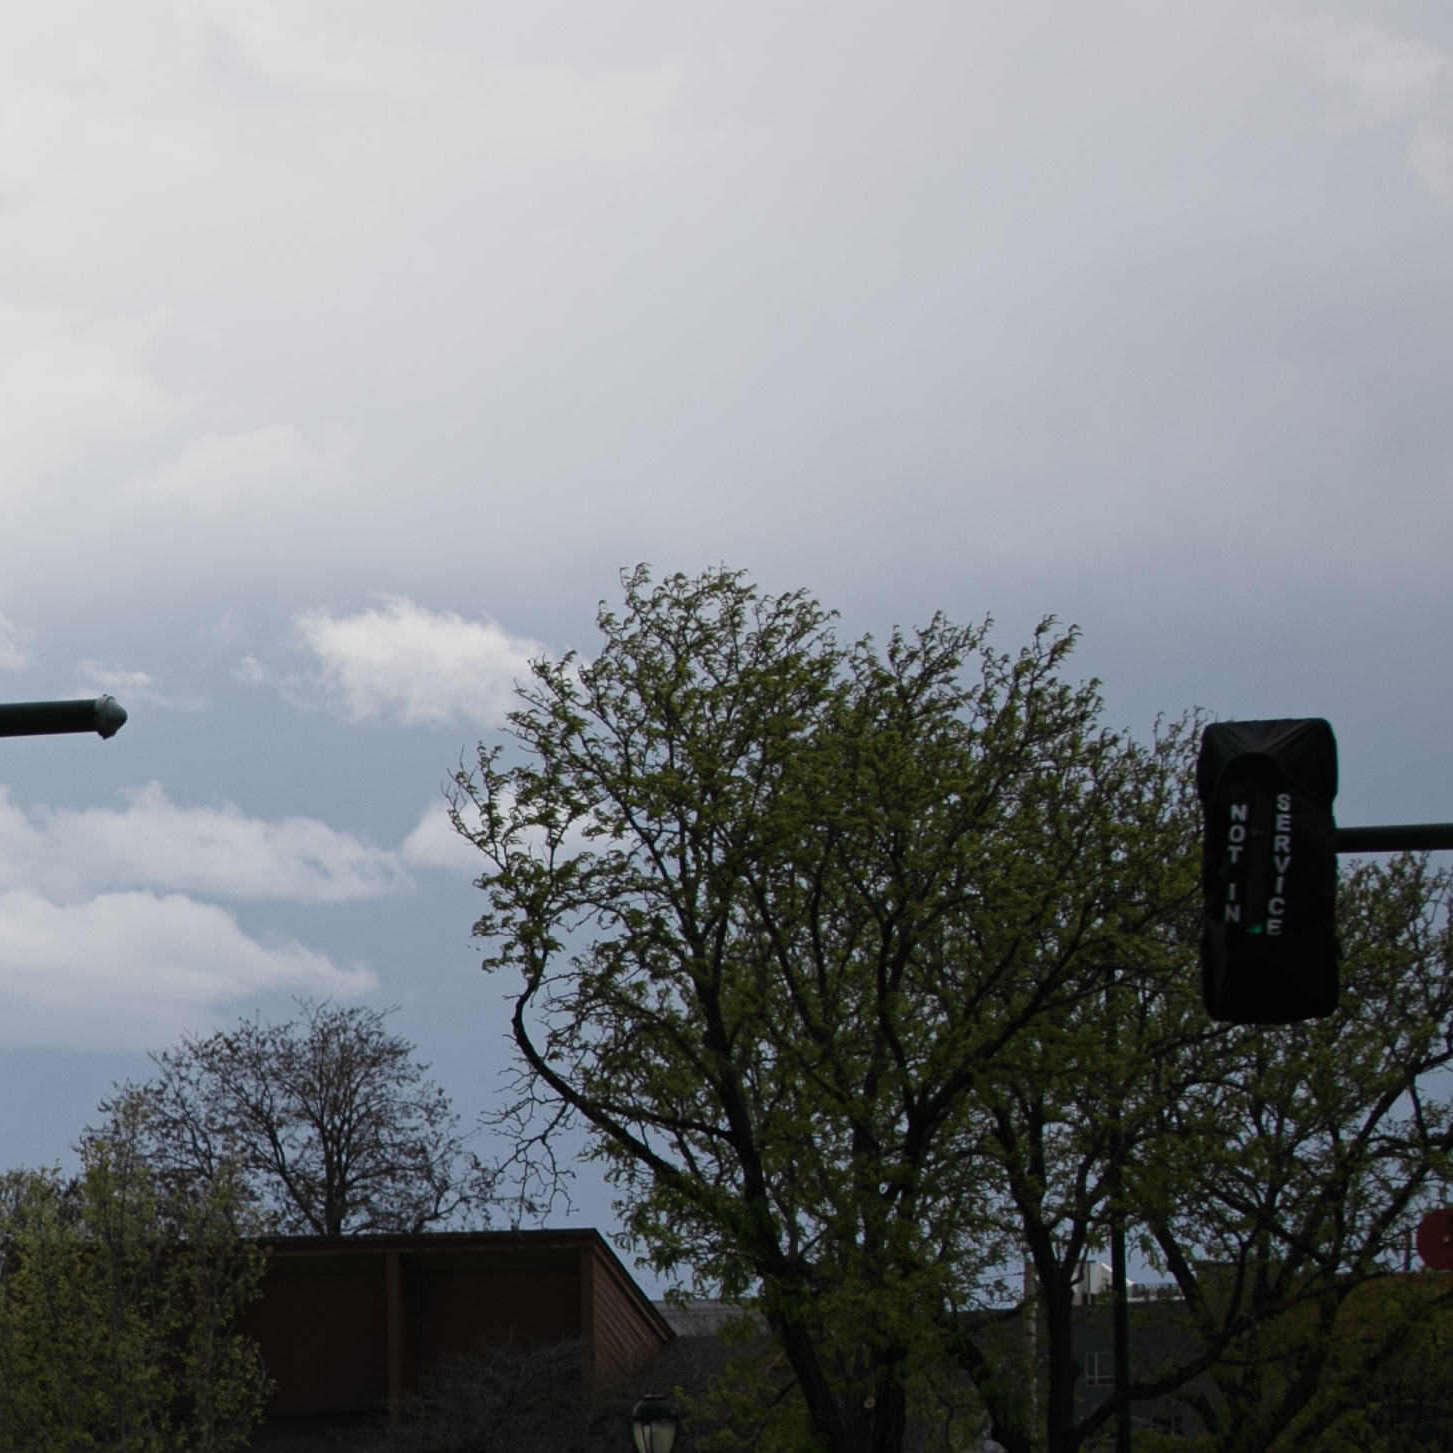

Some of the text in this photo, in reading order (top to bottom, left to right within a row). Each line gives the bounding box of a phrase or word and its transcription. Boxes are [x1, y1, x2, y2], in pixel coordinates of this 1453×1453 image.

[1224, 803, 1248, 923] NOT IN
[1265, 793, 1292, 936] SERVICE
